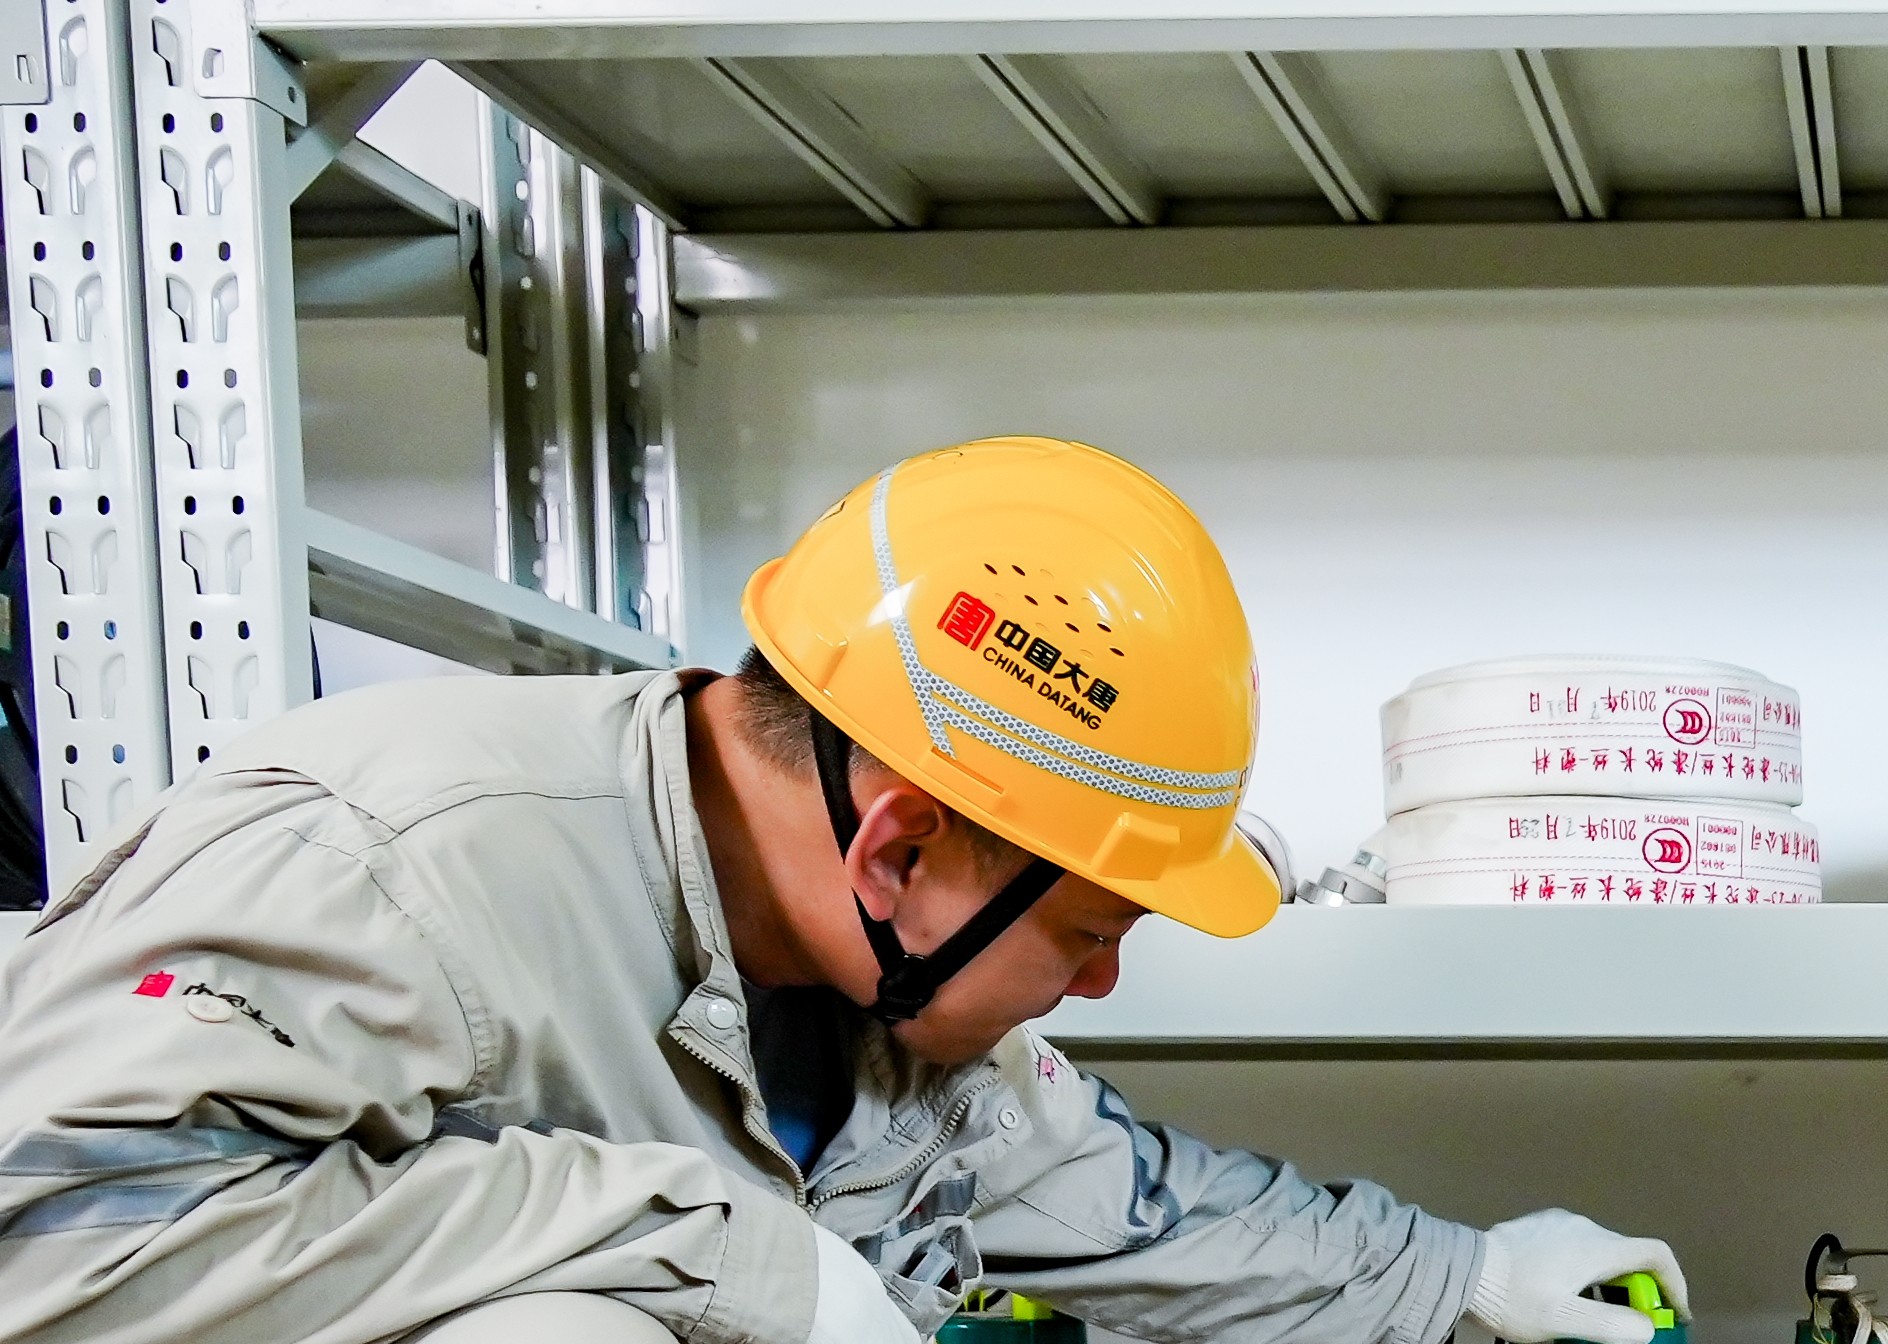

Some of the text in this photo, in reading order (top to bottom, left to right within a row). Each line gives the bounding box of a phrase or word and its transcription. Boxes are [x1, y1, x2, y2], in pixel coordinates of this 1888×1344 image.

[983, 647, 1102, 730] CHINA DATANG
[994, 619, 1120, 713] 中国大唐
